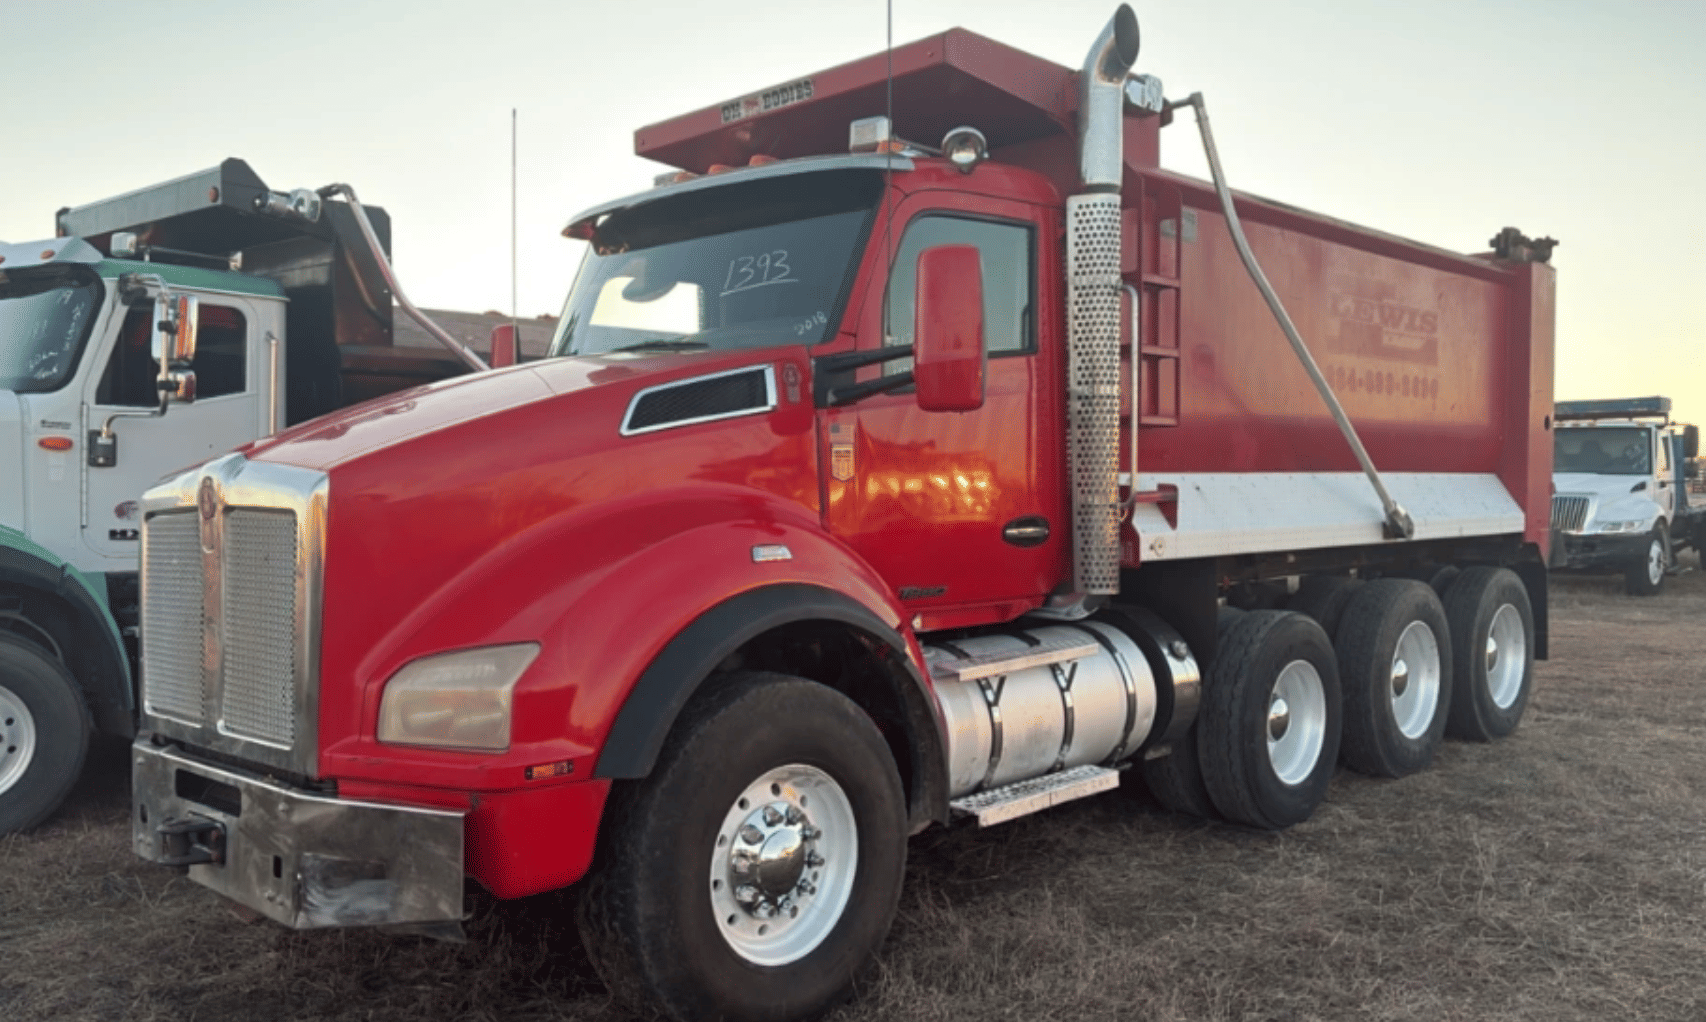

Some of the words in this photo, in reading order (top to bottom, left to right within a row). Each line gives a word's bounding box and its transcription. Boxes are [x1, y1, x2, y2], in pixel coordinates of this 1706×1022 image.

[722, 249, 792, 293] 1393
[794, 311, 828, 336] 2018
[1329, 296, 1439, 334] LEWIS
